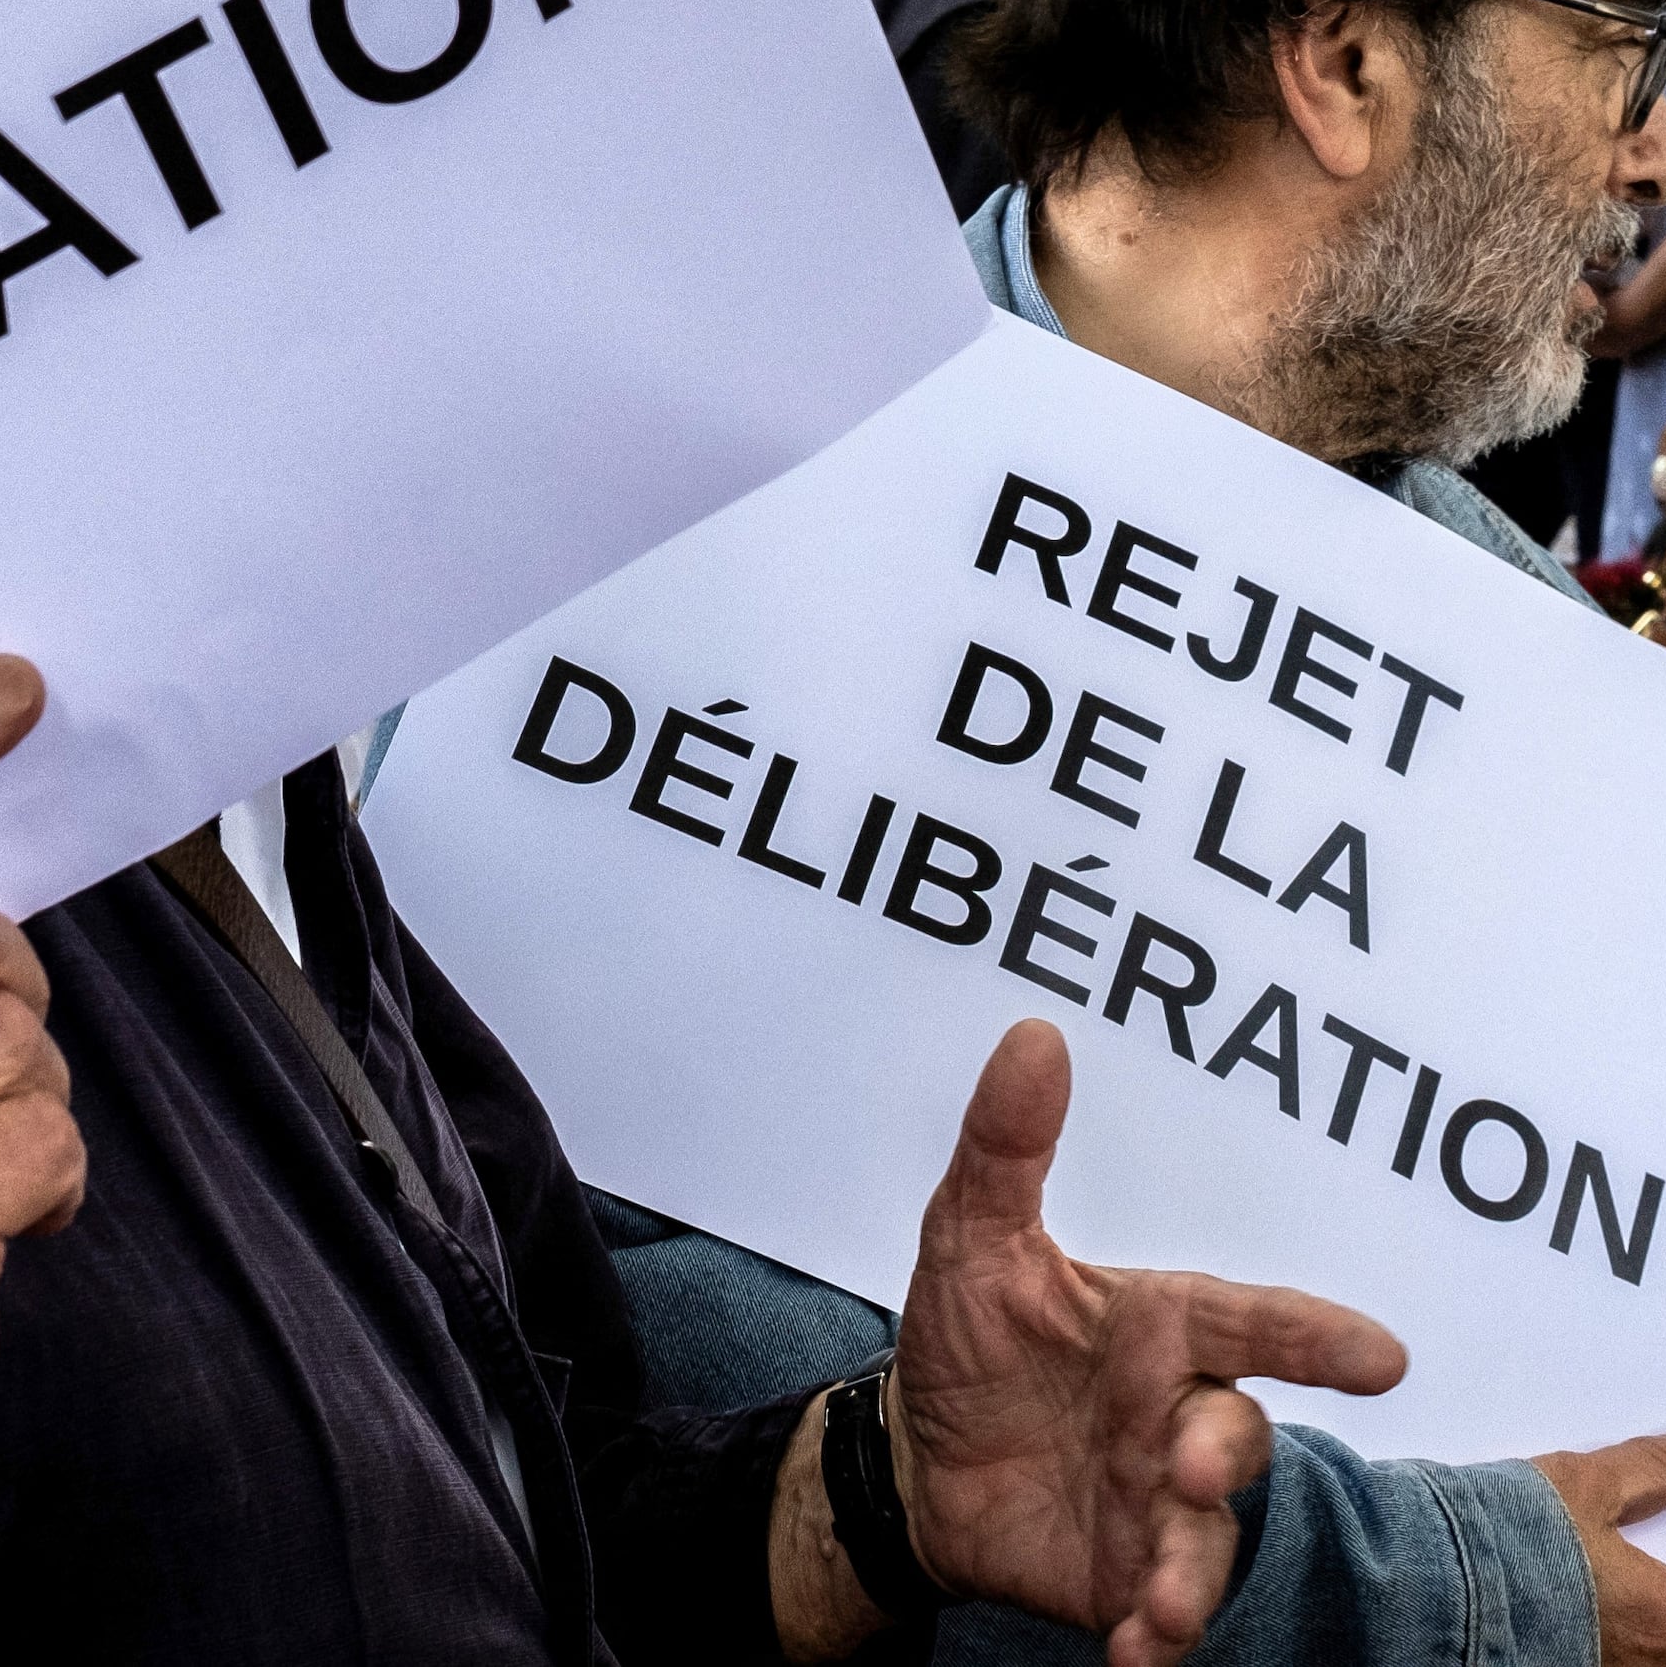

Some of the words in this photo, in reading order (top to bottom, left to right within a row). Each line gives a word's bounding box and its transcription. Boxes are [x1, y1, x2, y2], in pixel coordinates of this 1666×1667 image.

[975, 472, 1463, 776] REJET
[936, 642, 1165, 829] DE
[1194, 759, 1369, 953] LA
[512, 656, 1664, 1286] DÉLIBÉRATION
